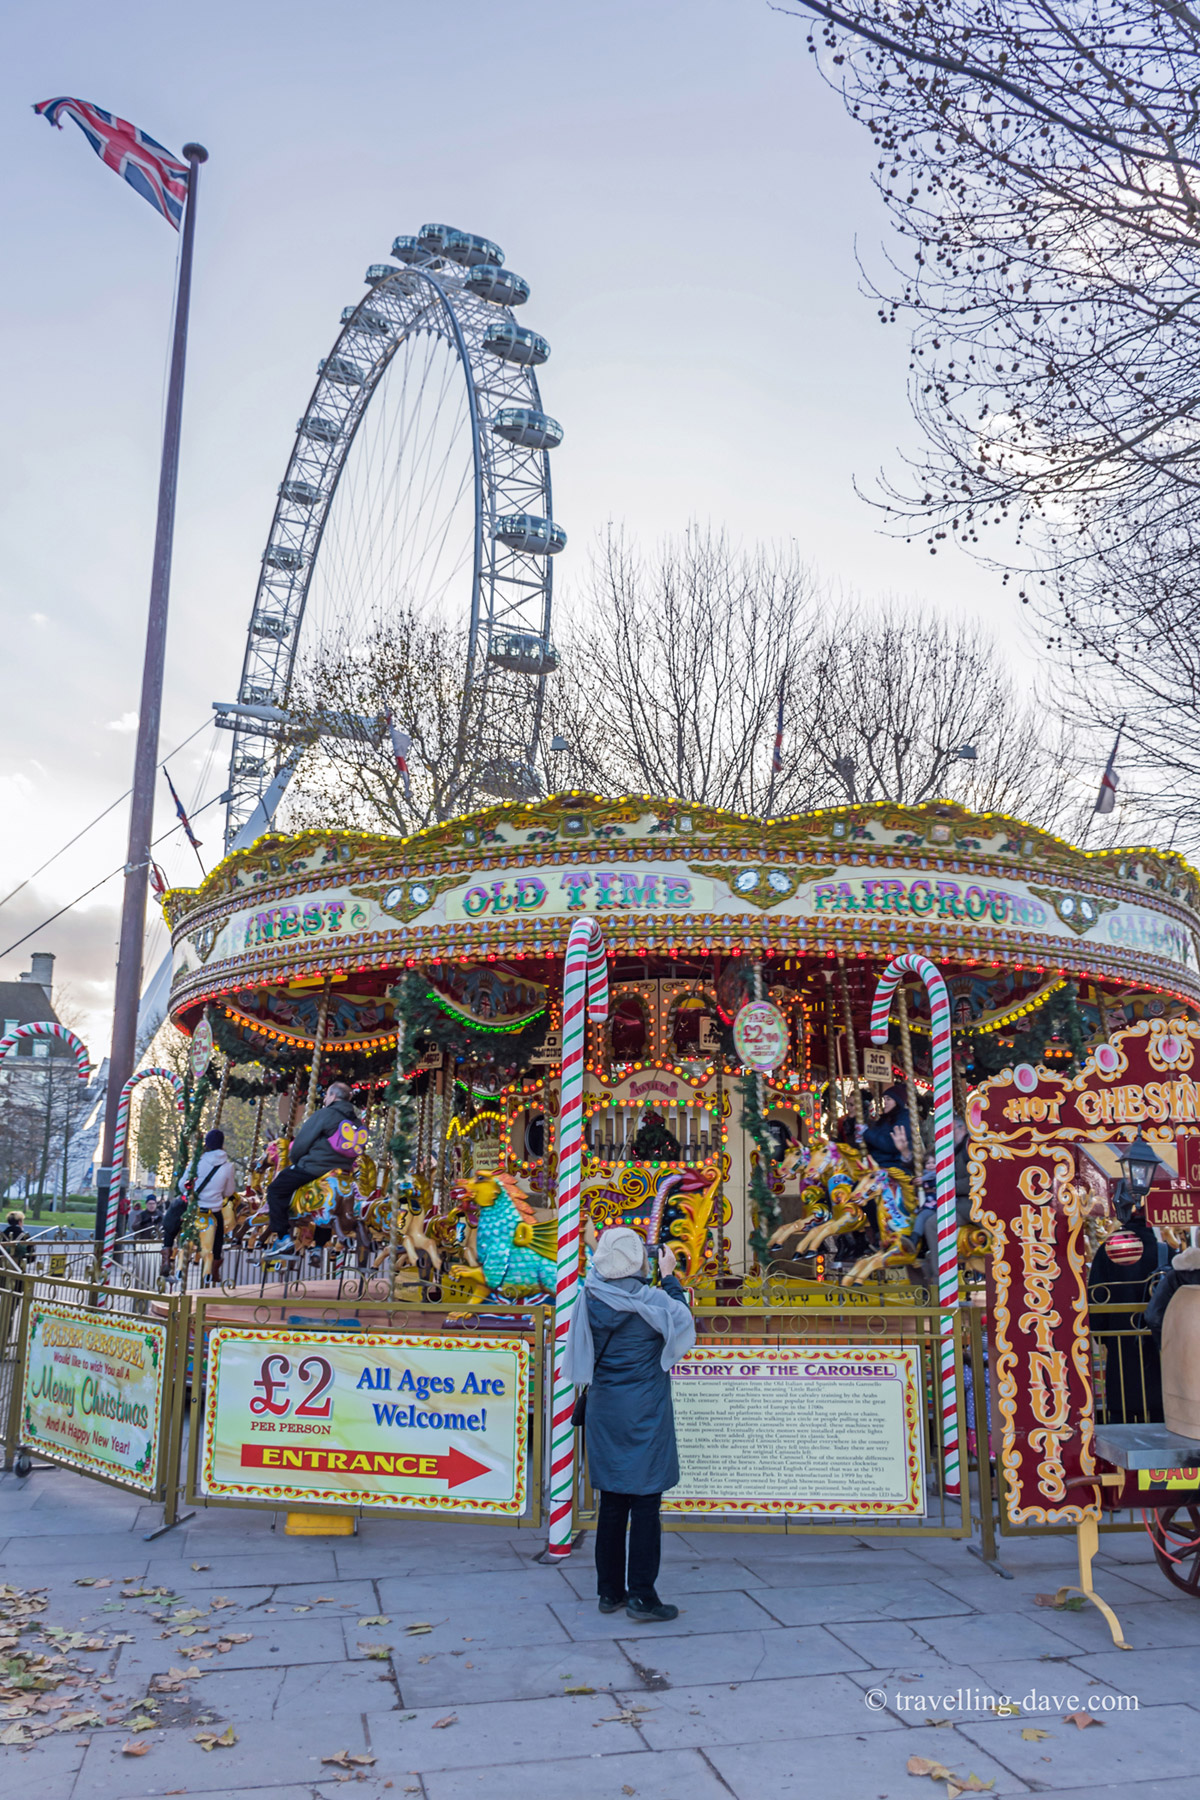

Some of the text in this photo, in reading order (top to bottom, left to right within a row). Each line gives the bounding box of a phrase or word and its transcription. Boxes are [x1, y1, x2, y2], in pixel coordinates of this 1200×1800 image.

[463, 869, 695, 917] OLD TIME
[813, 878, 1047, 929] FAIRGROUND
[870, 1053, 886, 1065] NO
[1002, 1091, 1066, 1125] HOT
[1153, 1209, 1194, 1223] LARGE
[1171, 1193, 1195, 1207] ALL
[42, 1323, 146, 1370] GOLDEN CAROUSEL
[1010, 1165, 1075, 1503] CHESTNUTS
[53, 1351, 130, 1380] Would like to wish You all A
[669, 1364, 894, 1377] HISTORY OF THE CAROUSEL
[31, 1364, 148, 1430] Merry Christmas
[249, 1353, 335, 1420] £2
[355, 1366, 506, 1401] All Ages Are
[250, 1421, 332, 1435] PER PERSON
[372, 1402, 489, 1432] Welcome!
[45, 1415, 131, 1455] And A Happy New Year!
[261, 1447, 439, 1476] ENTRANCE
